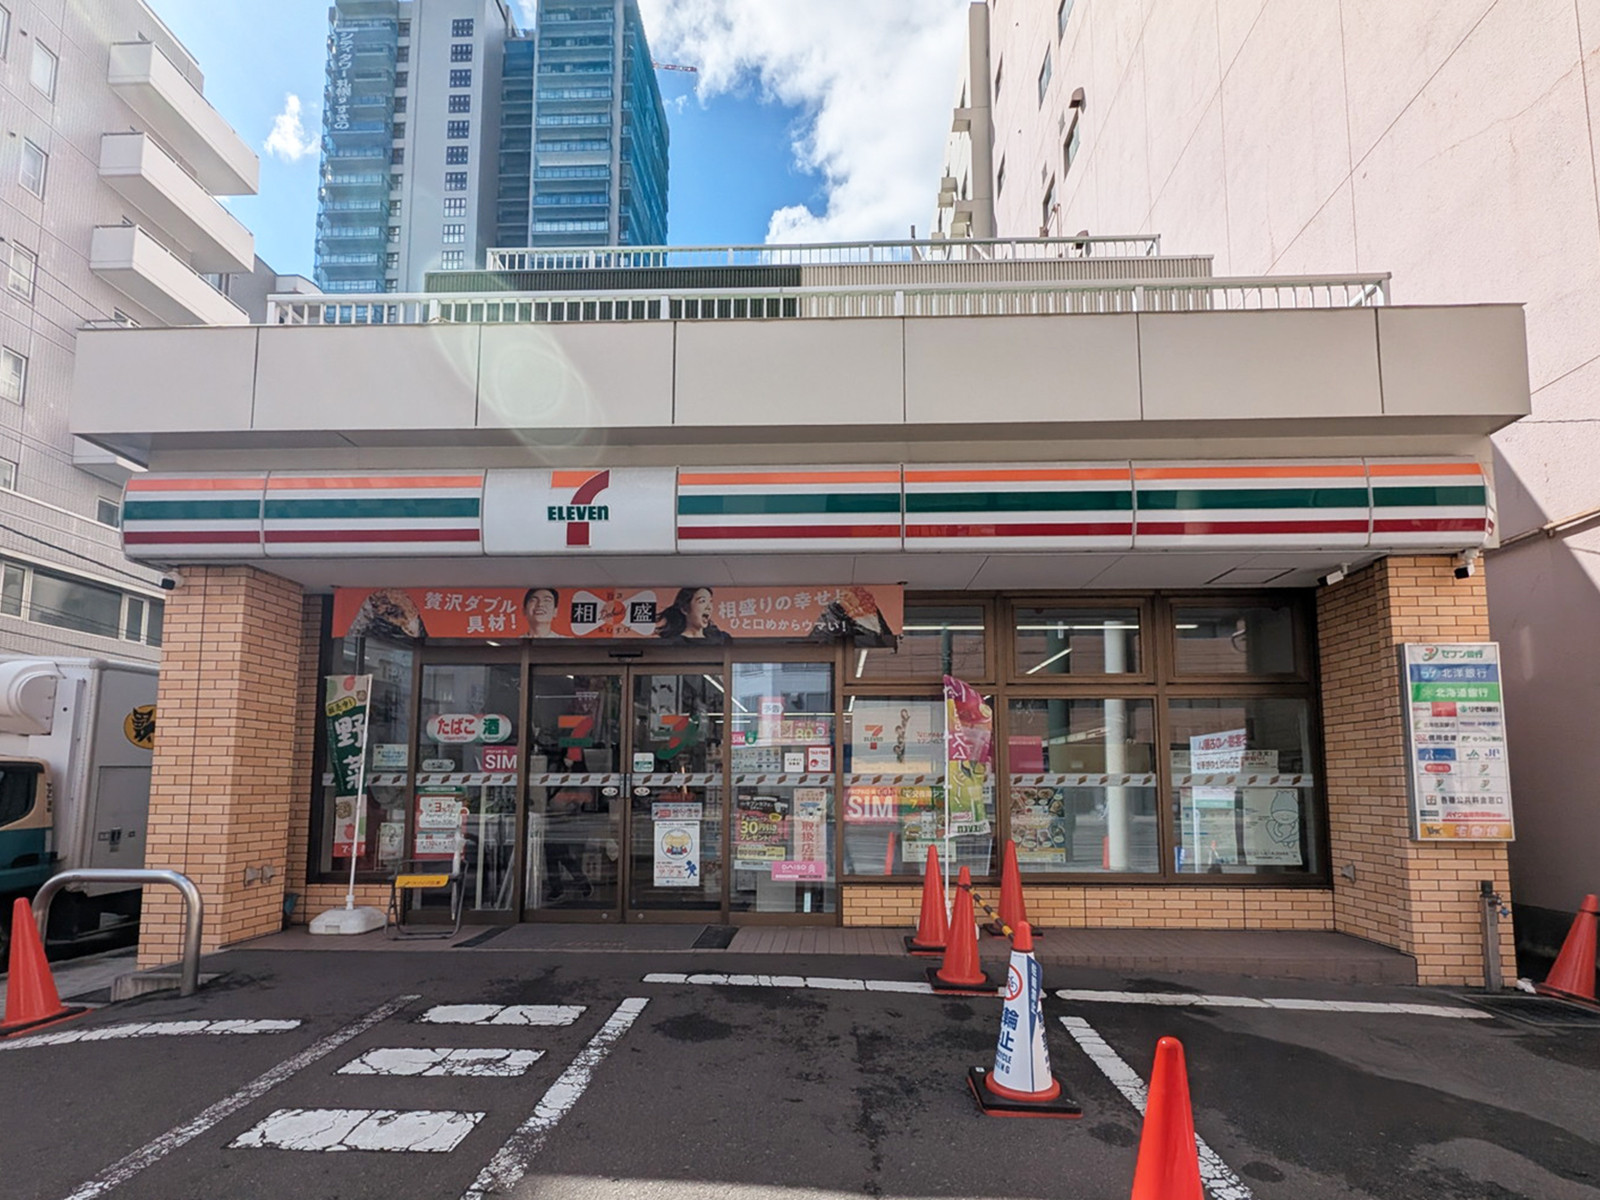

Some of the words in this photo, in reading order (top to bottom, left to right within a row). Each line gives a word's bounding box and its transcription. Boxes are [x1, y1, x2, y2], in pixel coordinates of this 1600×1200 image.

[551, 469, 610, 546] 7
[424, 591, 517, 614] 贅沢ダブル
[573, 603, 594, 623] 相
[632, 604, 653, 623] 盛
[466, 614, 517, 634] 具材!
[729, 617, 847, 632] ひと口めからウマい!
[1441, 668, 1488, 679] 北洋銀行
[1435, 687, 1489, 698] 北海道銀行
[436, 717, 476, 736] たばこ
[482, 717, 500, 736] 酒
[485, 754, 517, 769] SIM
[847, 796, 893, 818] SIM
